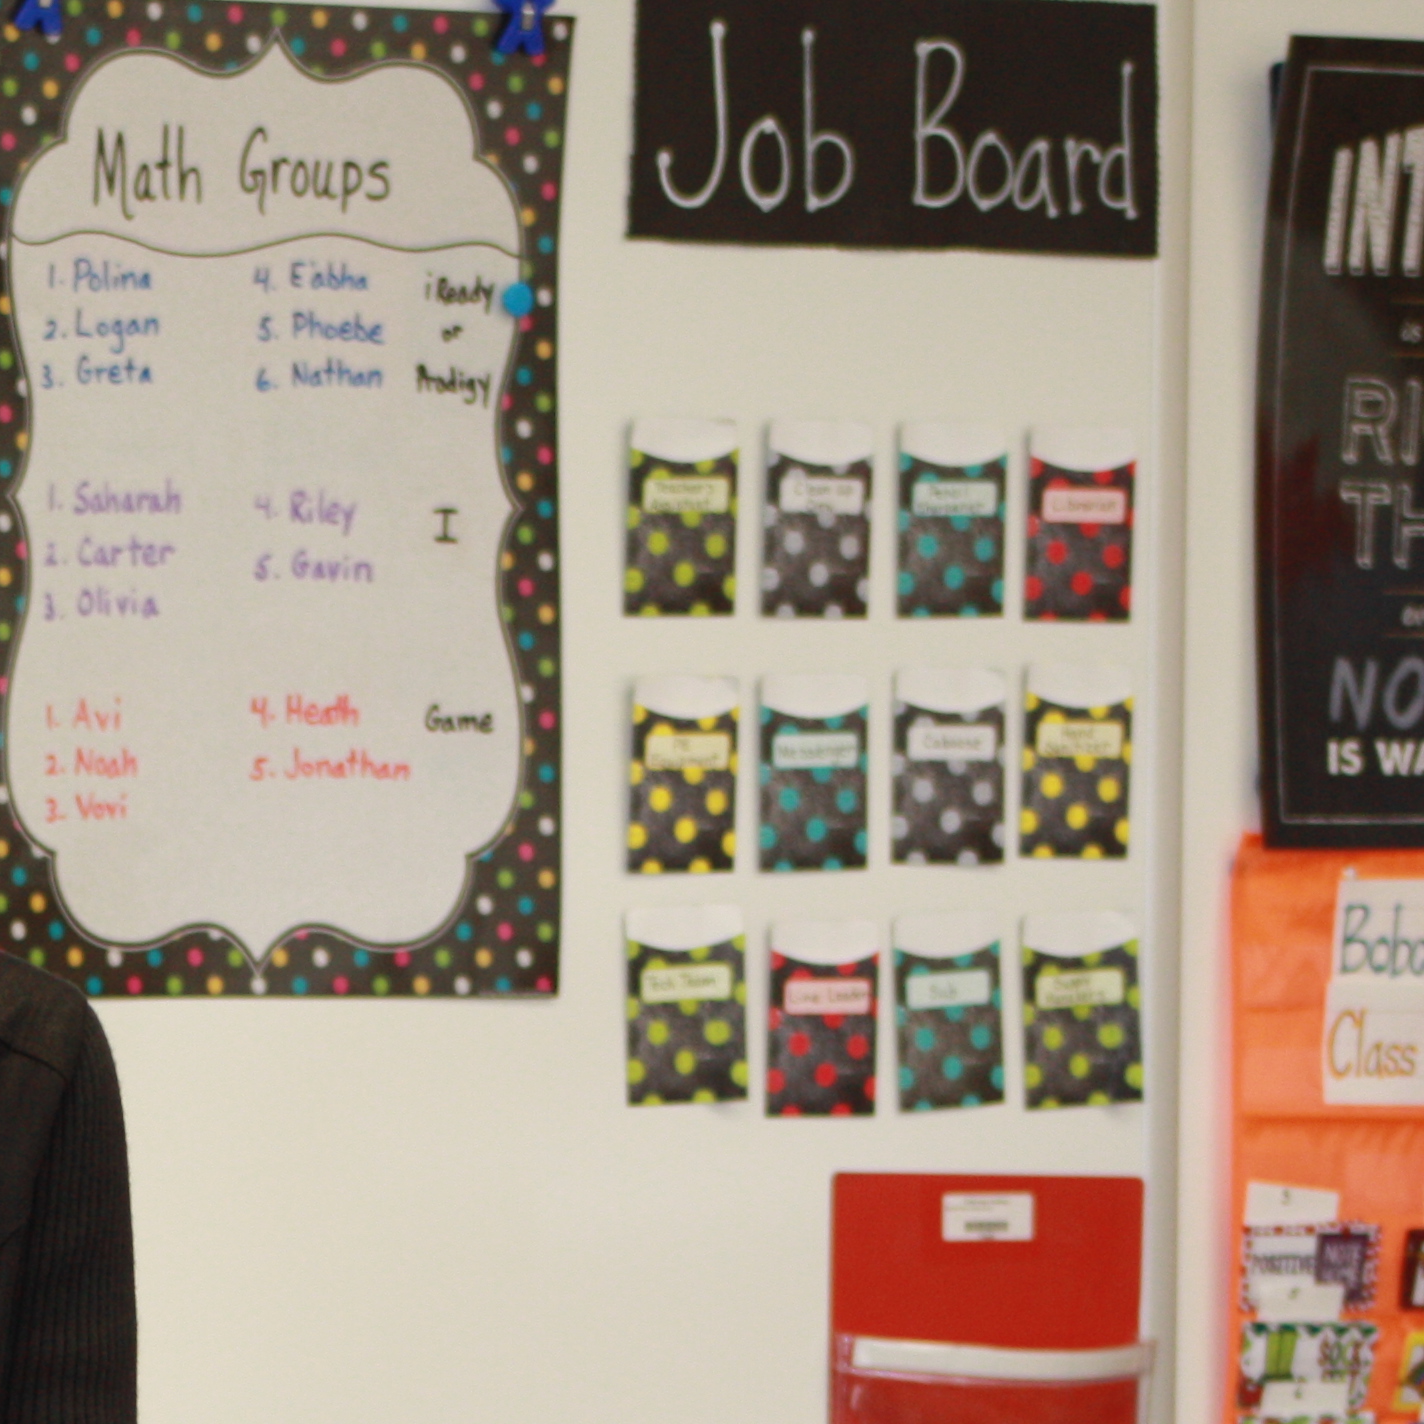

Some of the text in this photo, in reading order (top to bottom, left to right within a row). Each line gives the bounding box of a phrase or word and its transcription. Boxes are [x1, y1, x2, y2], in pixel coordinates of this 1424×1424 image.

[657, 19, 1139, 220] Job Board
[92, 125, 390, 220] Math Groups
[73, 258, 151, 292] Polina
[253, 266, 276, 293] 4.
[43, 308, 159, 354] 2. Logan
[258, 311, 386, 345] 5. Phoebe
[442, 325, 463, 342] or
[41, 355, 152, 388] 3. Greta
[256, 357, 383, 392] 6. Nathan
[290, 490, 356, 536] Riley
[78, 535, 175, 566] Carter
[292, 551, 372, 582] Gavin
[78, 586, 159, 618] Olivia
[1330, 657, 1424, 730] NO
[73, 697, 122, 732] Avi
[287, 694, 359, 728] Heath
[425, 703, 494, 734] Game
[74, 747, 138, 779] Noah
[285, 748, 411, 781] Jonathan
[1327, 739, 1363, 776] IS
[1328, 1008, 1418, 1080] Class
